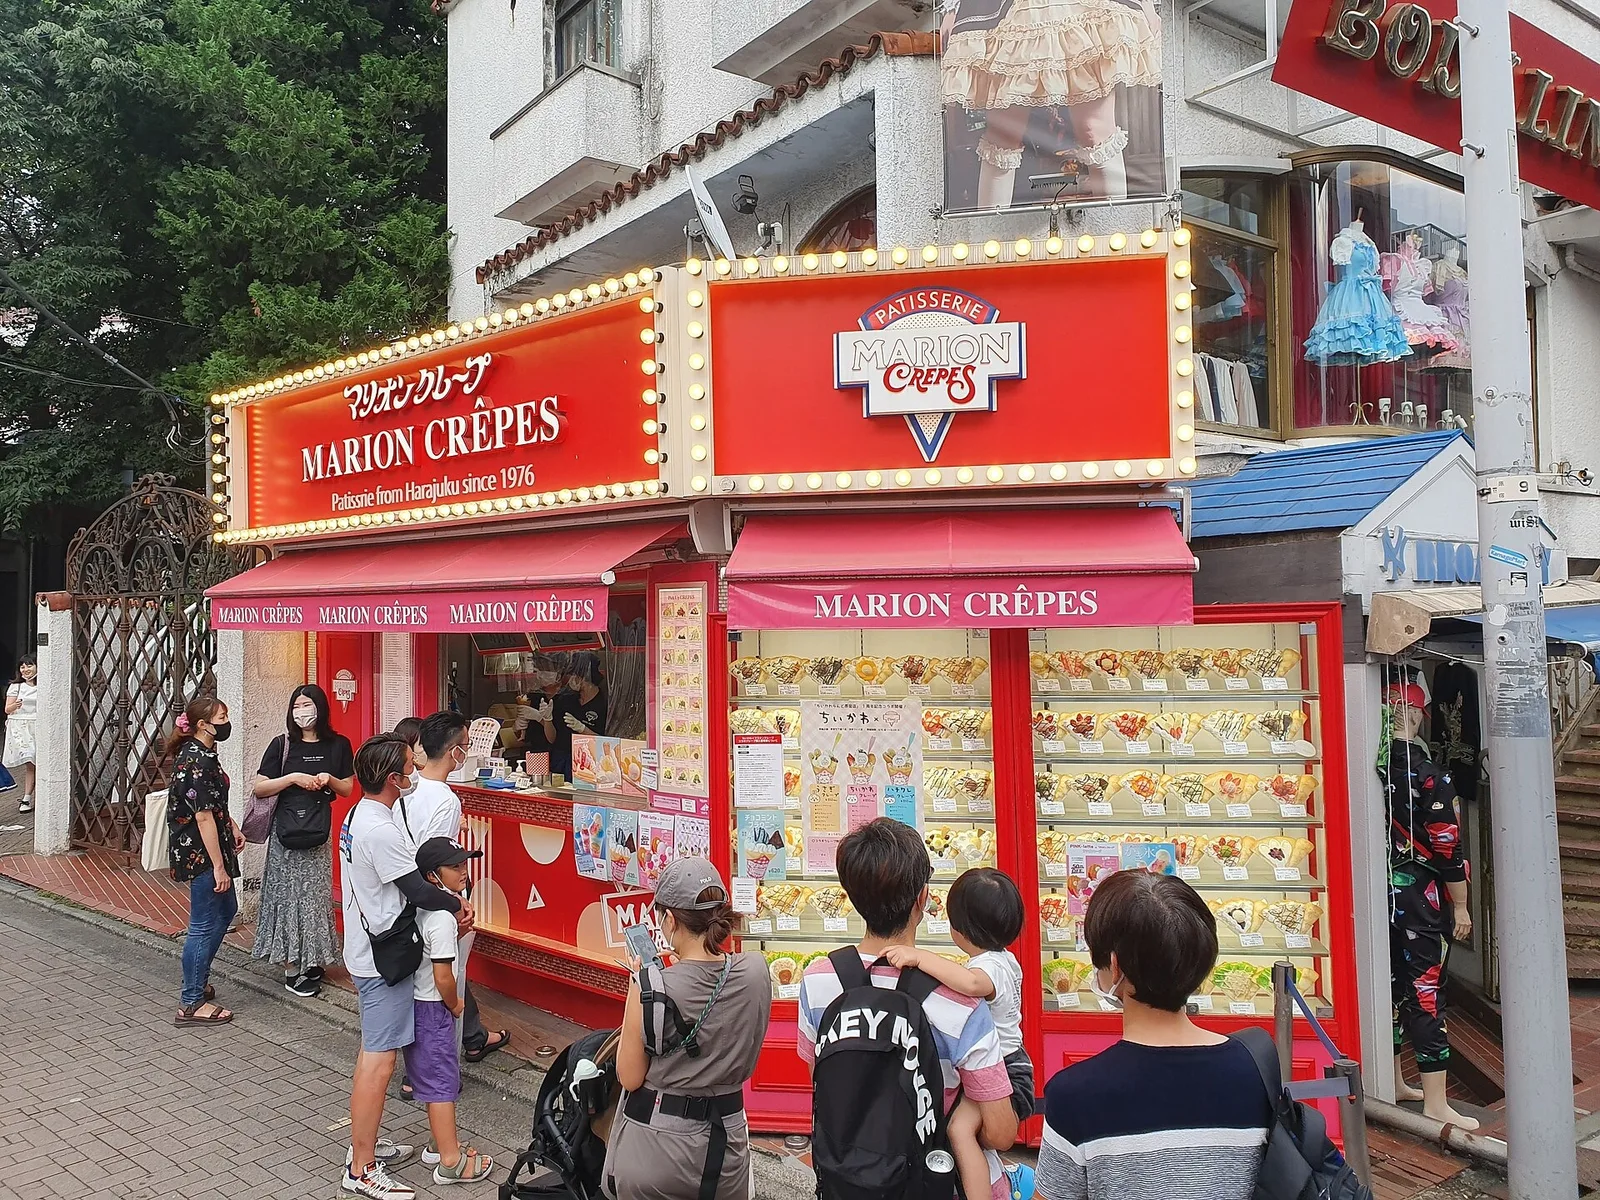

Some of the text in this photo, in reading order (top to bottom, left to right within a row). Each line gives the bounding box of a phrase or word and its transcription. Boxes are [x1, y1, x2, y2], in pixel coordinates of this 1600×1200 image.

[874, 290, 984, 325] PATISSERIE
[852, 331, 1012, 371] MARION
[343, 352, 492, 420] マリオンクレープ
[882, 363, 977, 404] CREPES
[301, 395, 561, 483] MARION CRÊPES
[331, 464, 536, 511] Patissrie from Harajuku since 1976
[1518, 480, 1529, 493] 9
[218, 602, 303, 625] MARION CRÊPES
[318, 599, 429, 626] MARION CRÊPES
[449, 593, 595, 625] MARION CRÊPES
[813, 584, 1099, 619] MARION CRÊPES
[819, 711, 870, 725] ちいかわ
[699, 876, 712, 885] POLO
